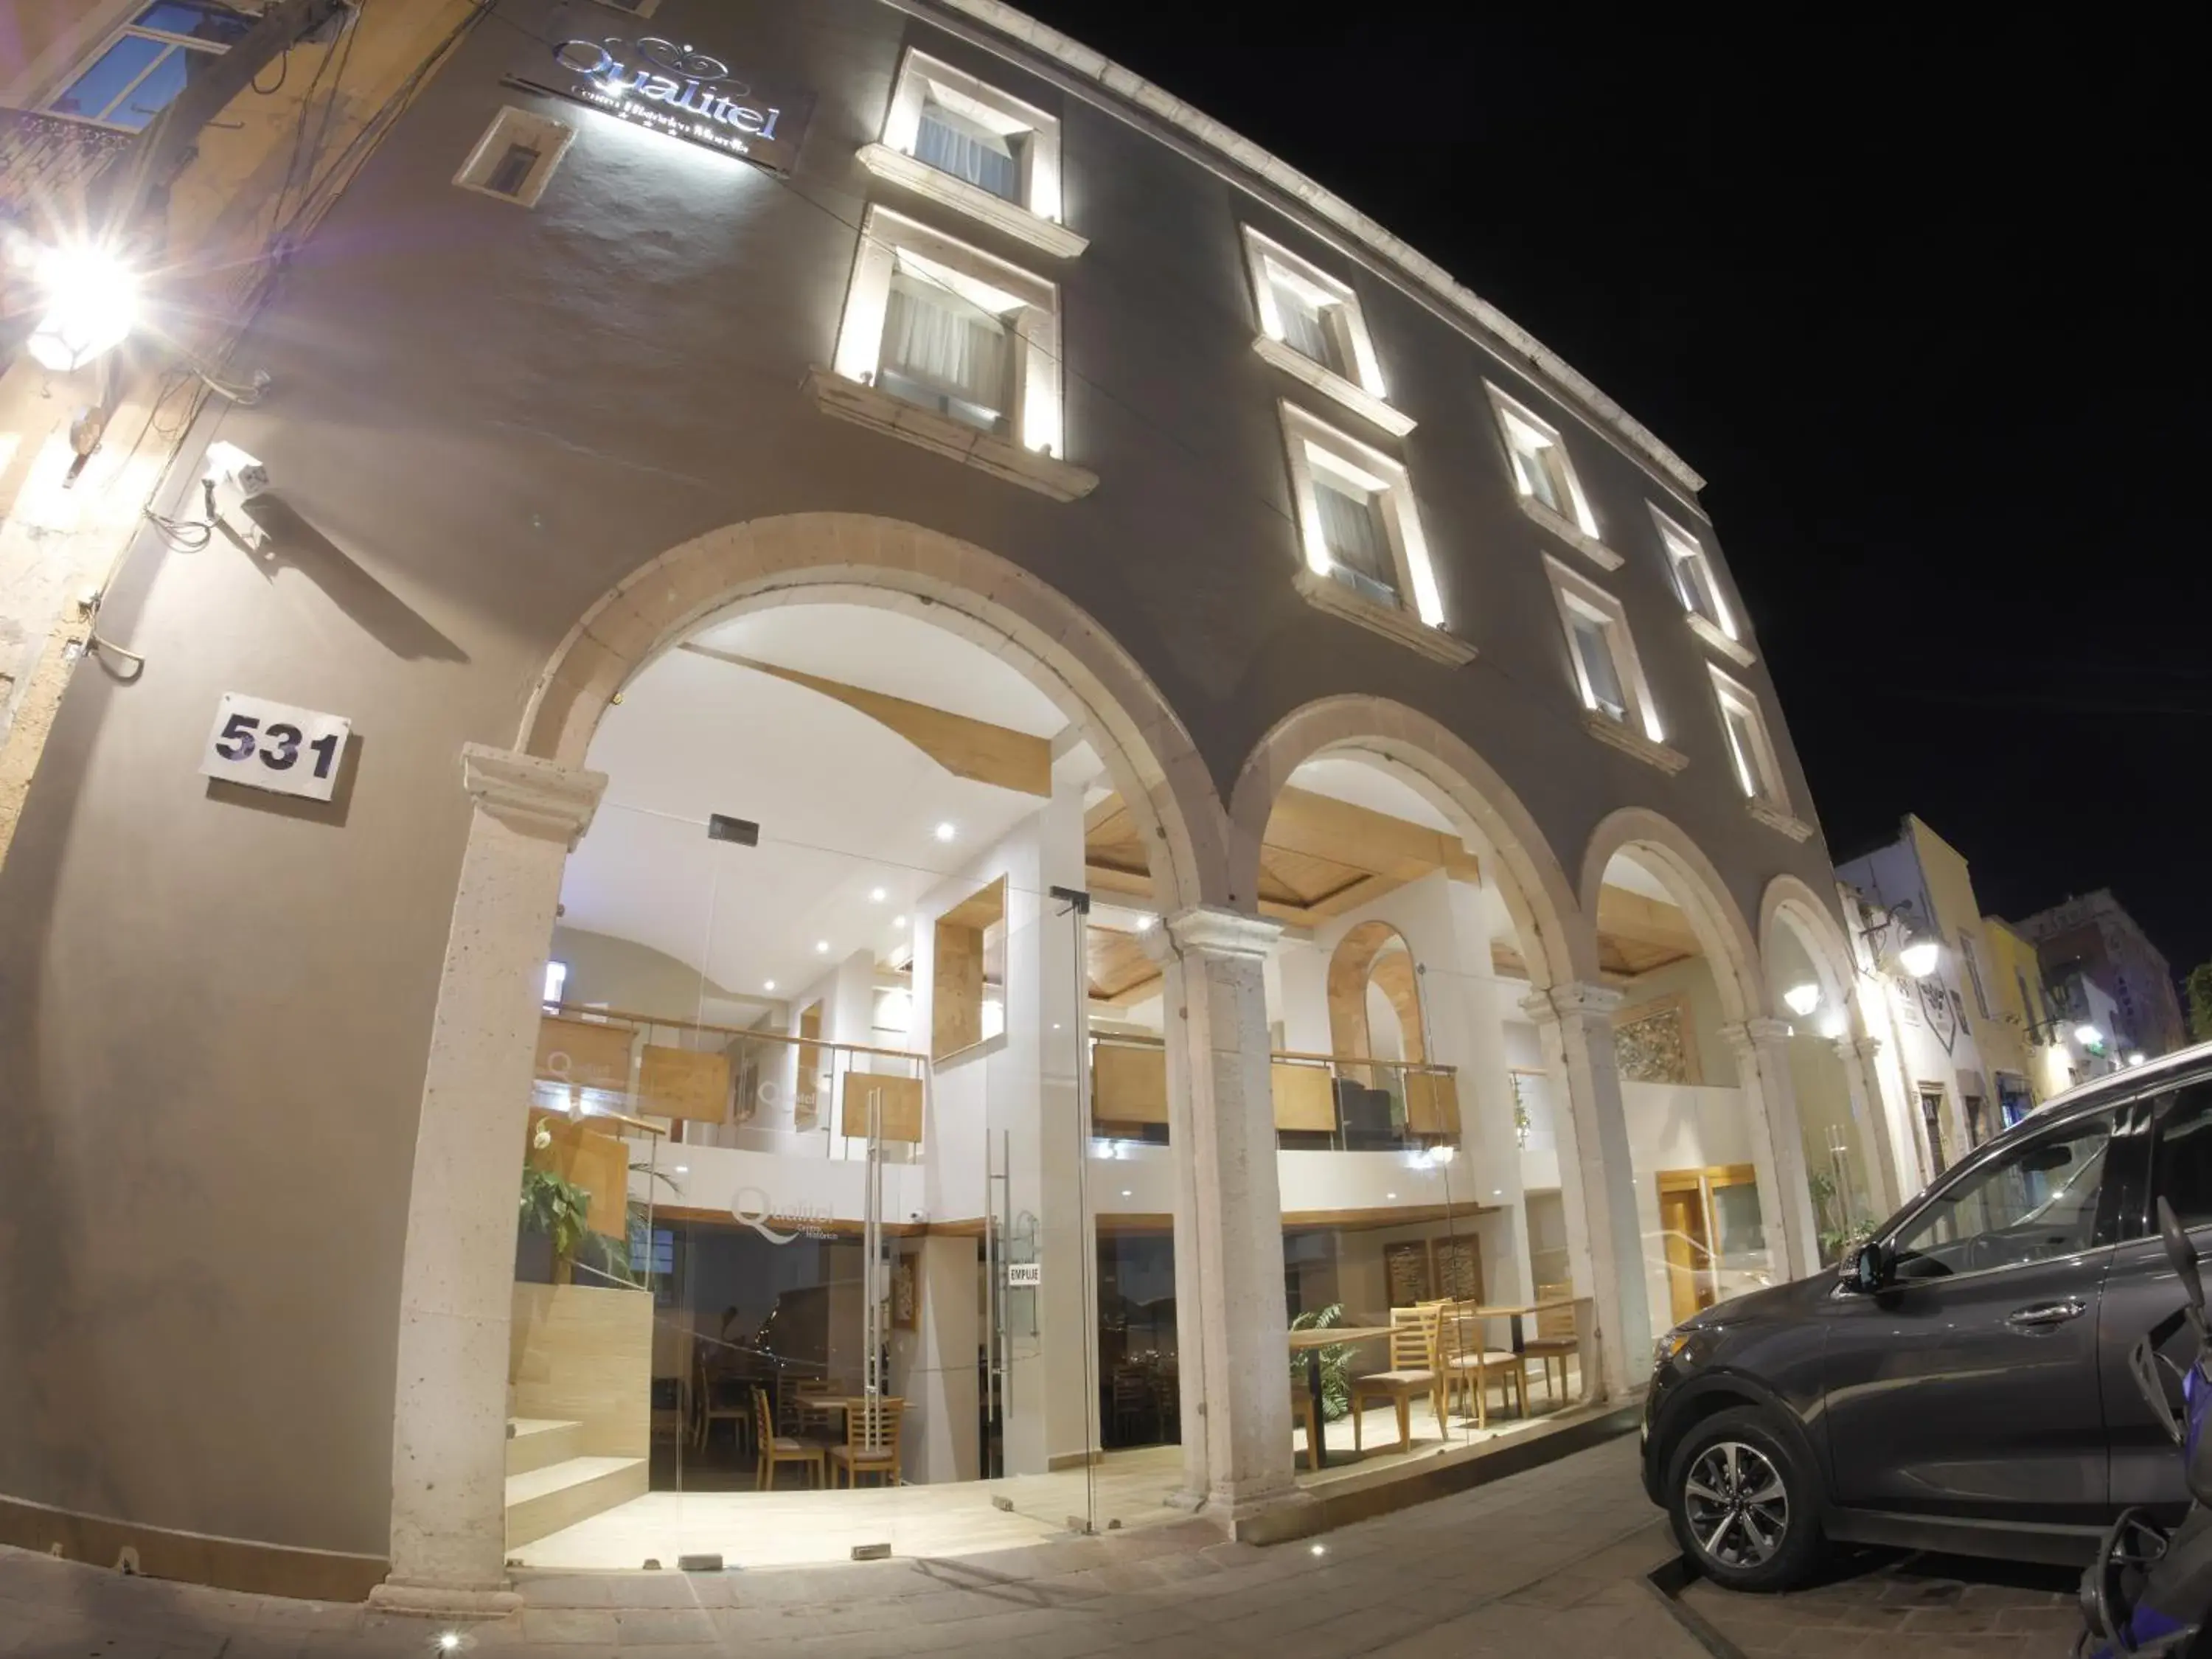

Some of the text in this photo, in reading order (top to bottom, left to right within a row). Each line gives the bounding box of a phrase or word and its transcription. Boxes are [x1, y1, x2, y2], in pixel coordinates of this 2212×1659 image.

[553, 39, 780, 140] Qualitel
[215, 713, 338, 779] 531
[731, 1186, 834, 1245] Qualitel
[1011, 1269, 1038, 1280] EMPUJE
